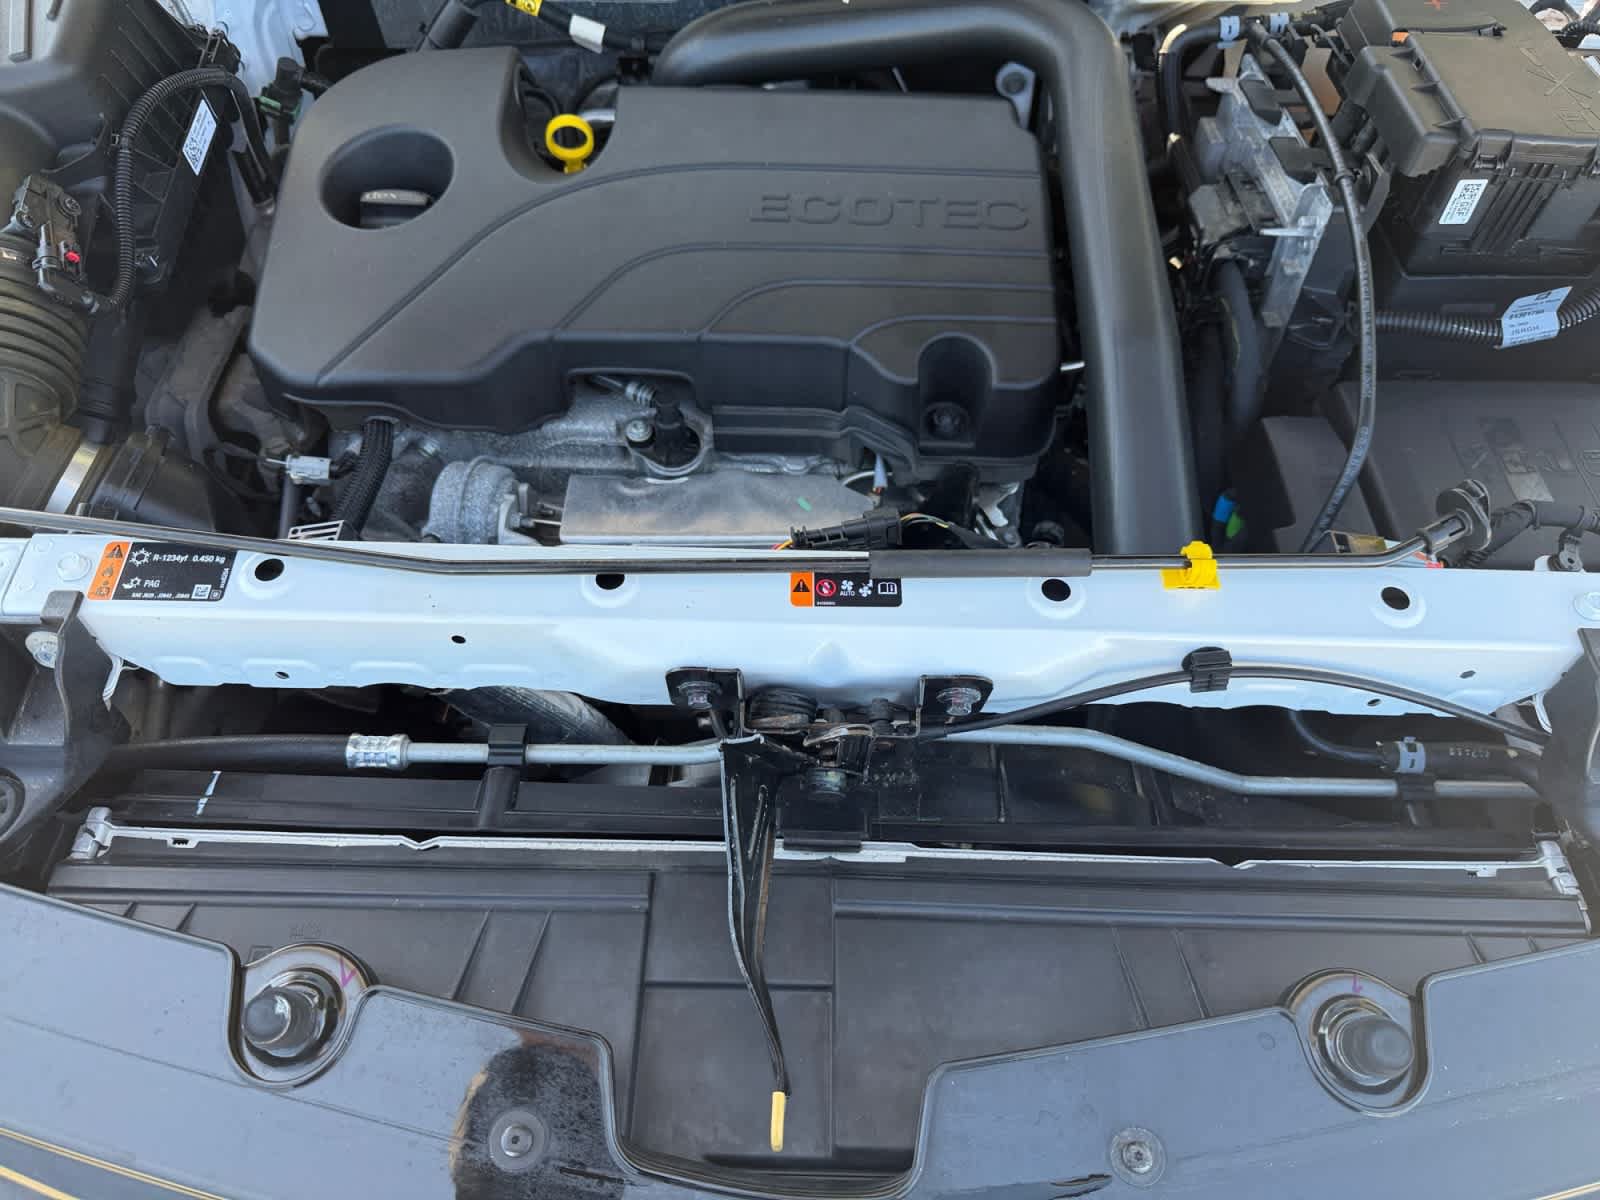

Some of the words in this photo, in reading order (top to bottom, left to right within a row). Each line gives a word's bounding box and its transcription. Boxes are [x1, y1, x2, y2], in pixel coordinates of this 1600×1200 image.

[747, 191, 1030, 232] ECOTEC
[152, 554, 188, 563] R-1234yf
[192, 555, 214, 563] 0.450
[215, 555, 226, 564] kg
[143, 579, 160, 588] PAG
